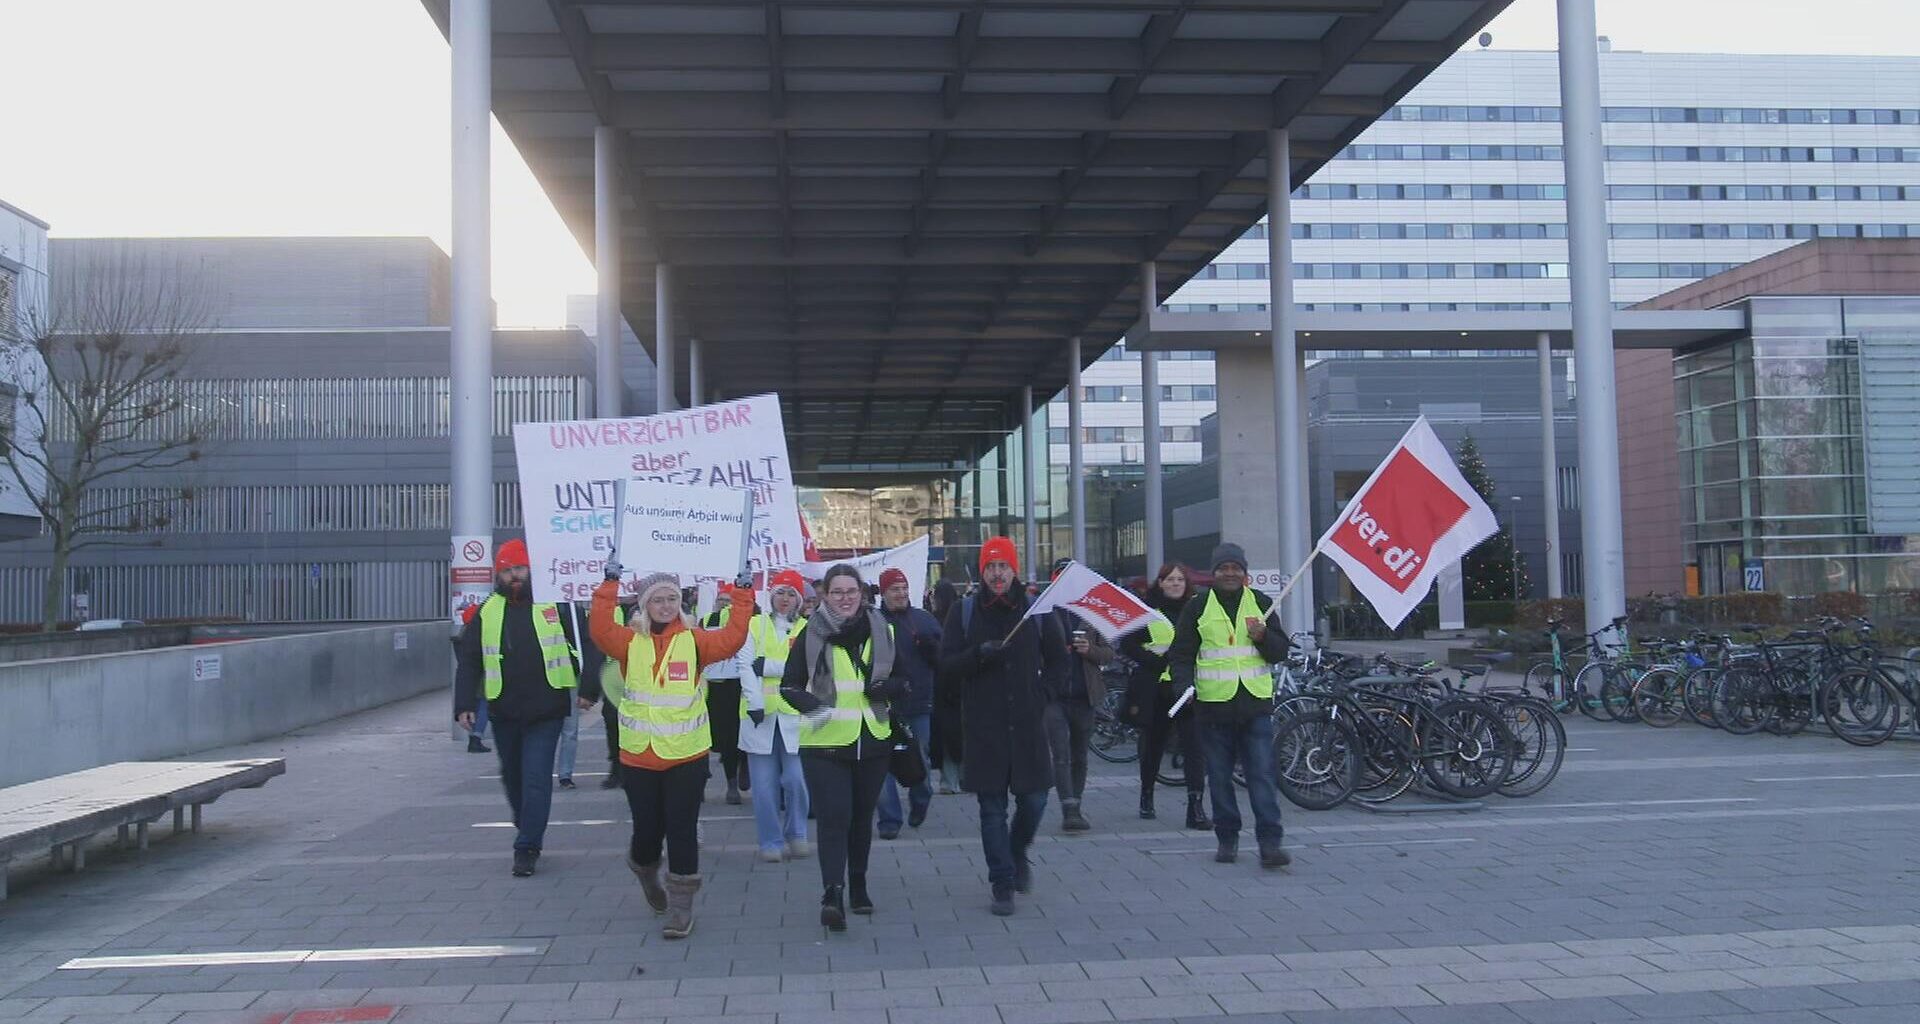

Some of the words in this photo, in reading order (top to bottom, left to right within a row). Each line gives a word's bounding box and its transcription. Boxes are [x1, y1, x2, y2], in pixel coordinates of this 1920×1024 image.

[550, 404, 752, 449] UNVERZICHTBAR
[631, 450, 691, 472] aber
[624, 504, 645, 516] Aus
[687, 507, 719, 522] Arbeit
[720, 512, 743, 523] wird
[652, 530, 712, 546] Gesundheit
[1747, 570, 1762, 591] 22
